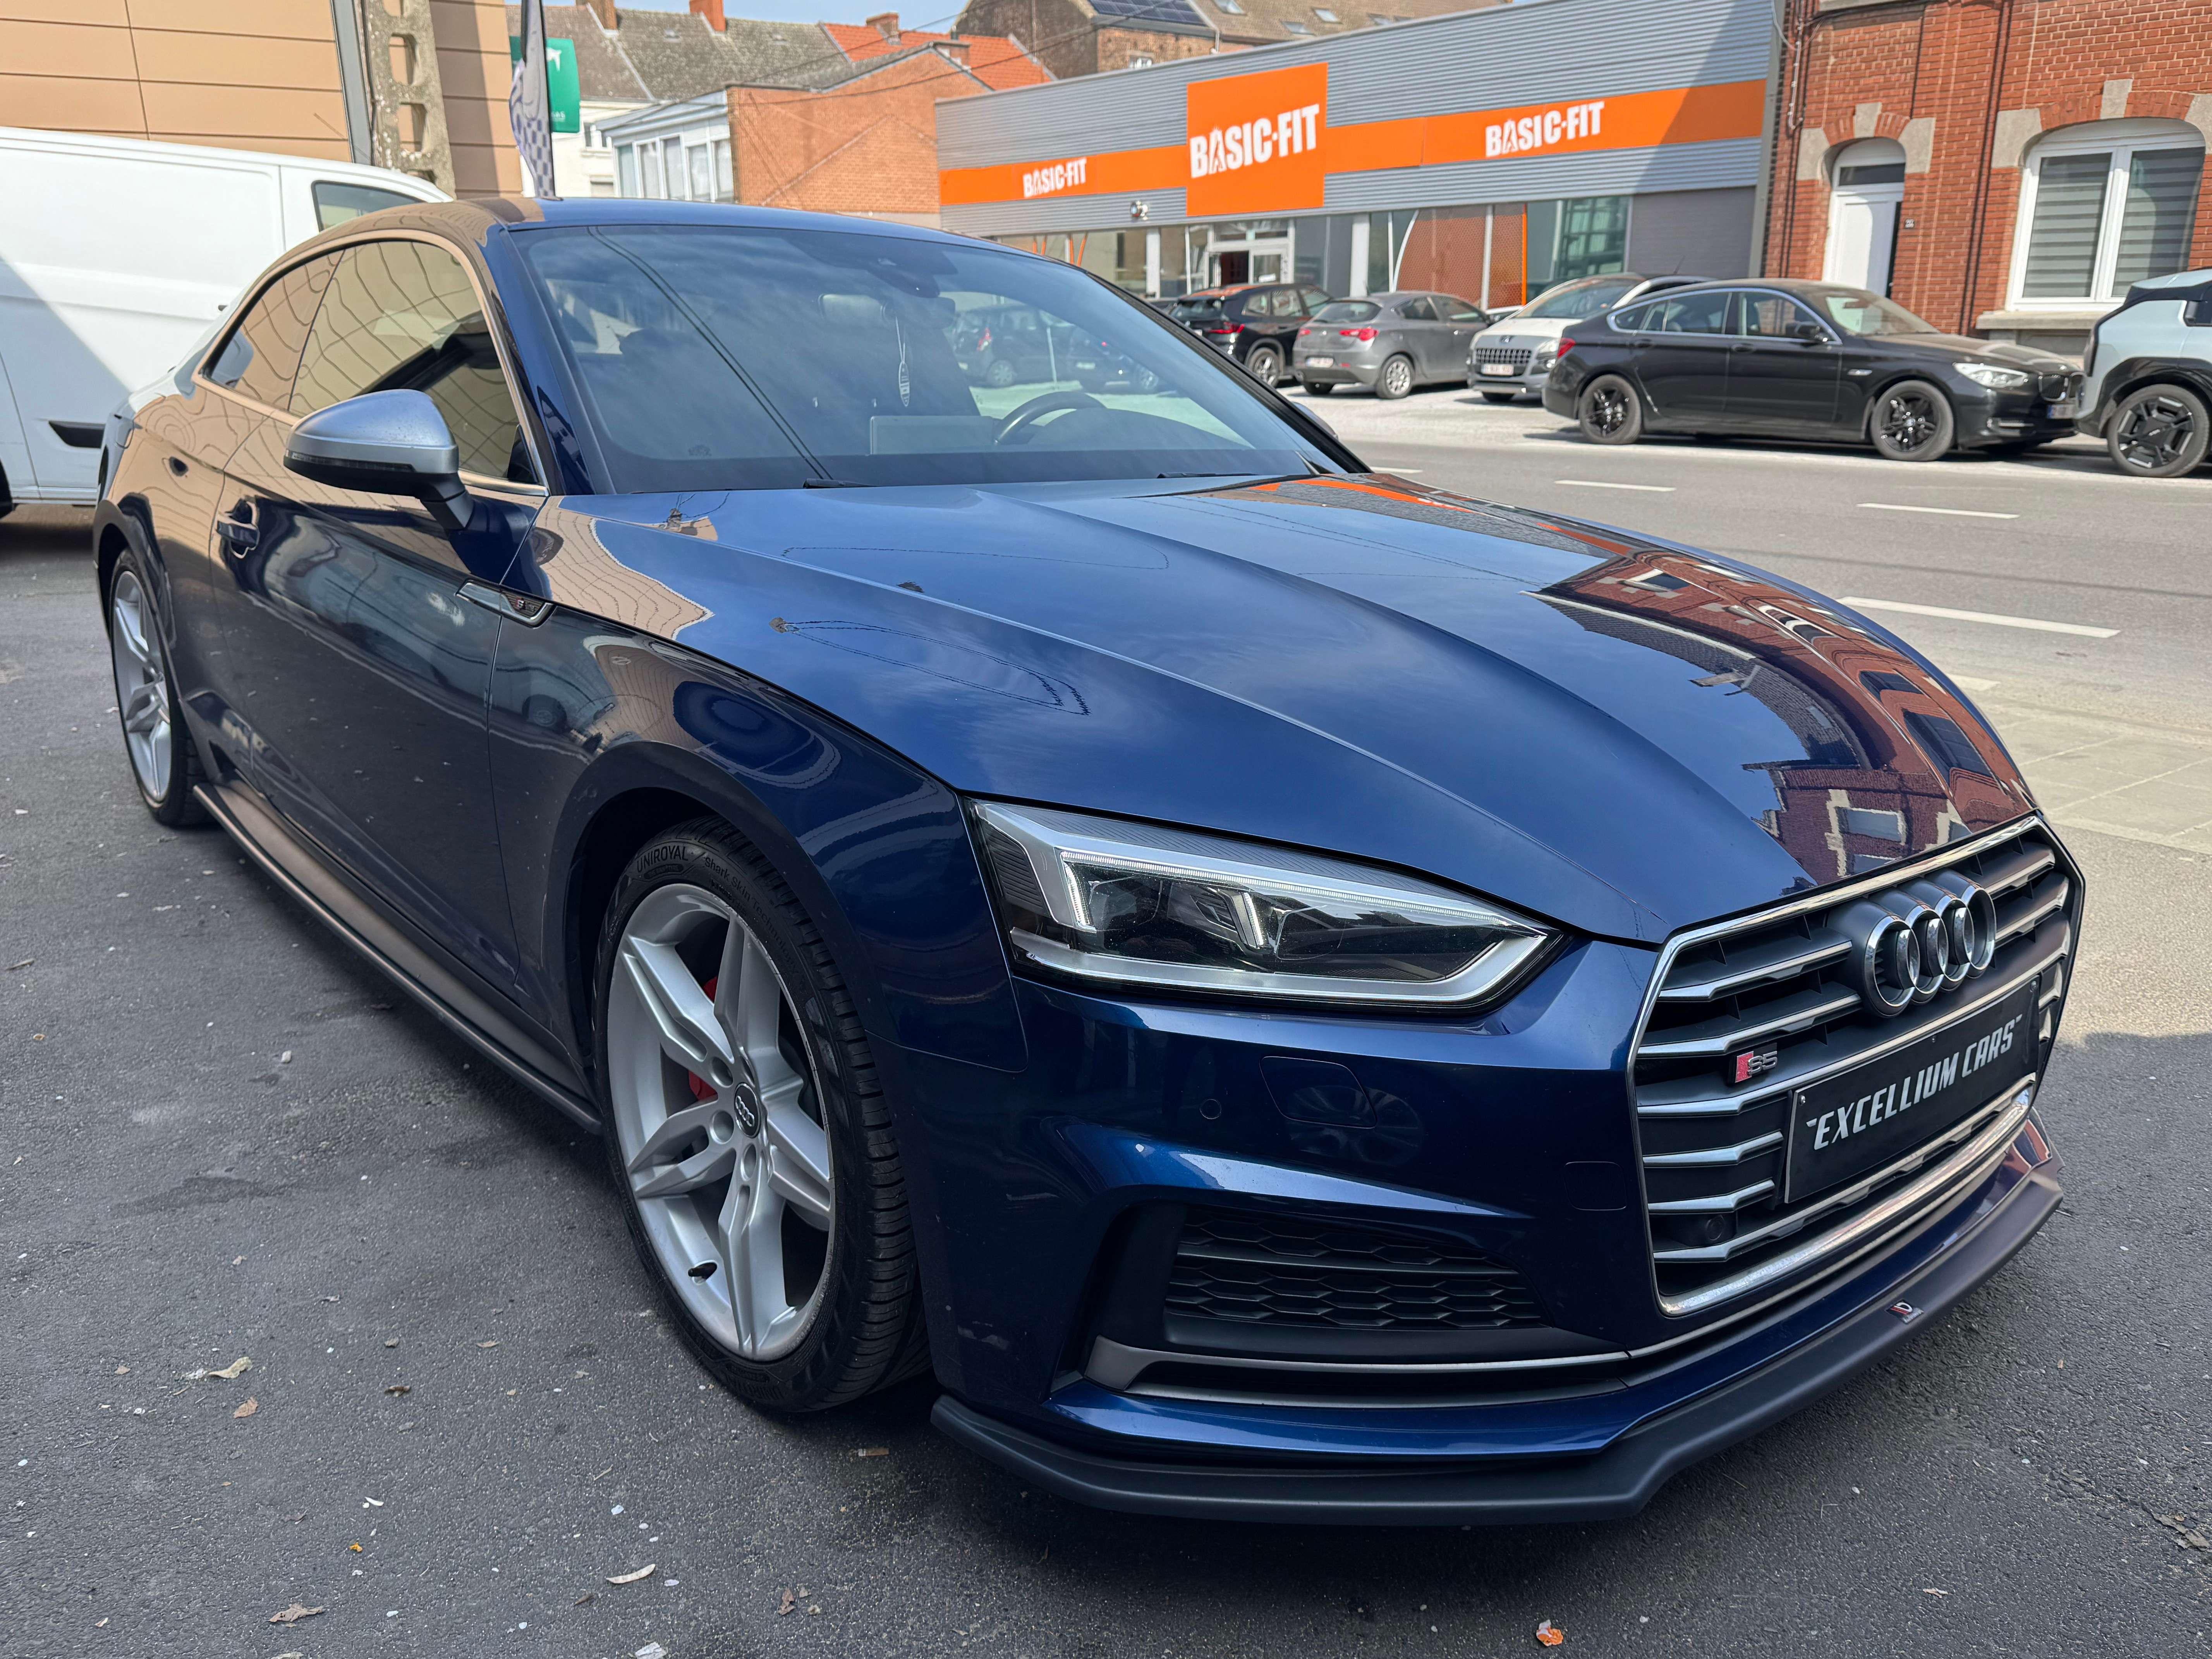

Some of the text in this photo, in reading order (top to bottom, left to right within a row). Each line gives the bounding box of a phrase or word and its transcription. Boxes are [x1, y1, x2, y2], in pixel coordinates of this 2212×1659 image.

[1190, 103, 1320, 179] BASIC-FIT
[1486, 101, 1605, 158] BASIC-FIT
[1023, 157, 1087, 198] BASIC-FIT
[637, 845, 688, 872] UNIROYAL
[704, 857, 730, 881] Shark
[731, 876, 751, 902] Skin
[1747, 1051, 1777, 1076] S5
[1807, 1014, 2022, 1150] EXCELLIUM CARS
